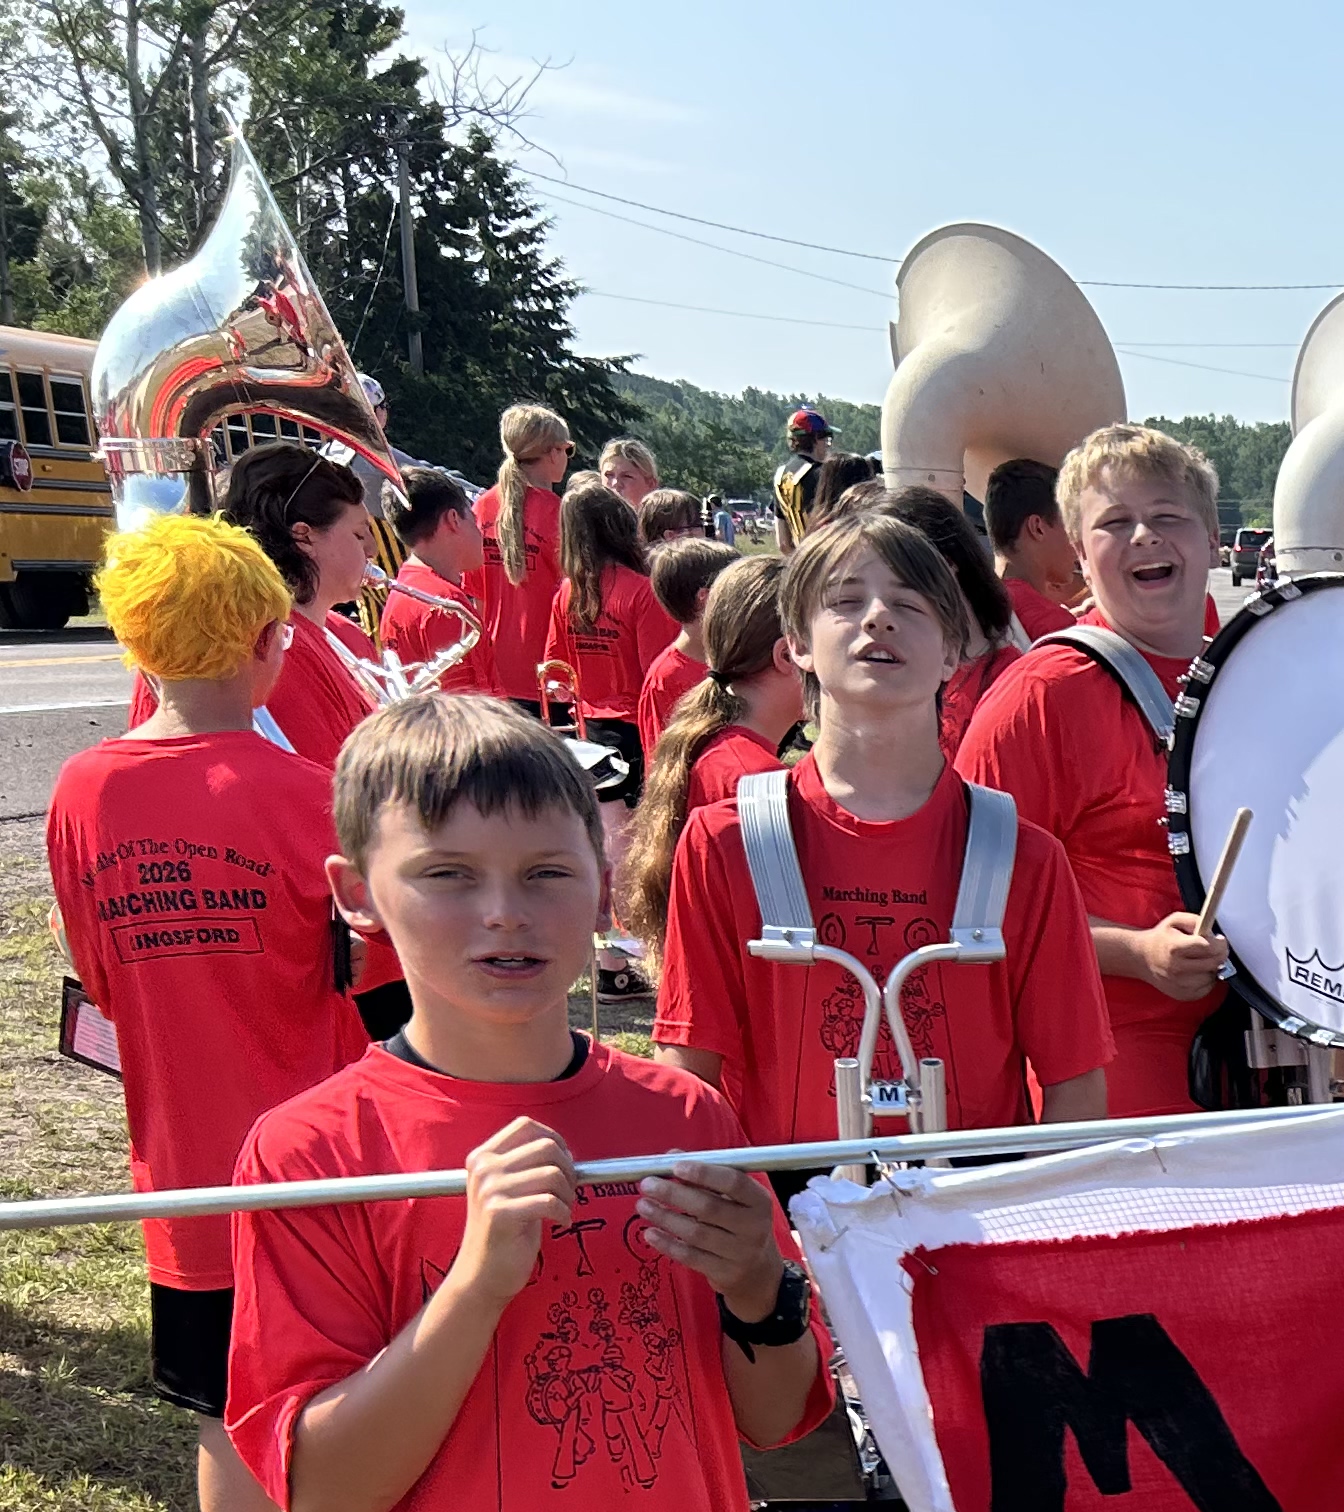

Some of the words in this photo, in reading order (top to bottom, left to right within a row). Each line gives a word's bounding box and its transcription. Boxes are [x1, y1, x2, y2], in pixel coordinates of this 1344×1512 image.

[136, 838, 169, 855] The
[174, 838, 218, 859] Open
[137, 860, 192, 885] 2026
[201, 888, 267, 911] BAND
[822, 886, 889, 907] Marching
[891, 889, 928, 905] Band
[130, 928, 241, 951] INGSFORD
[879, 1087, 899, 1102] M
